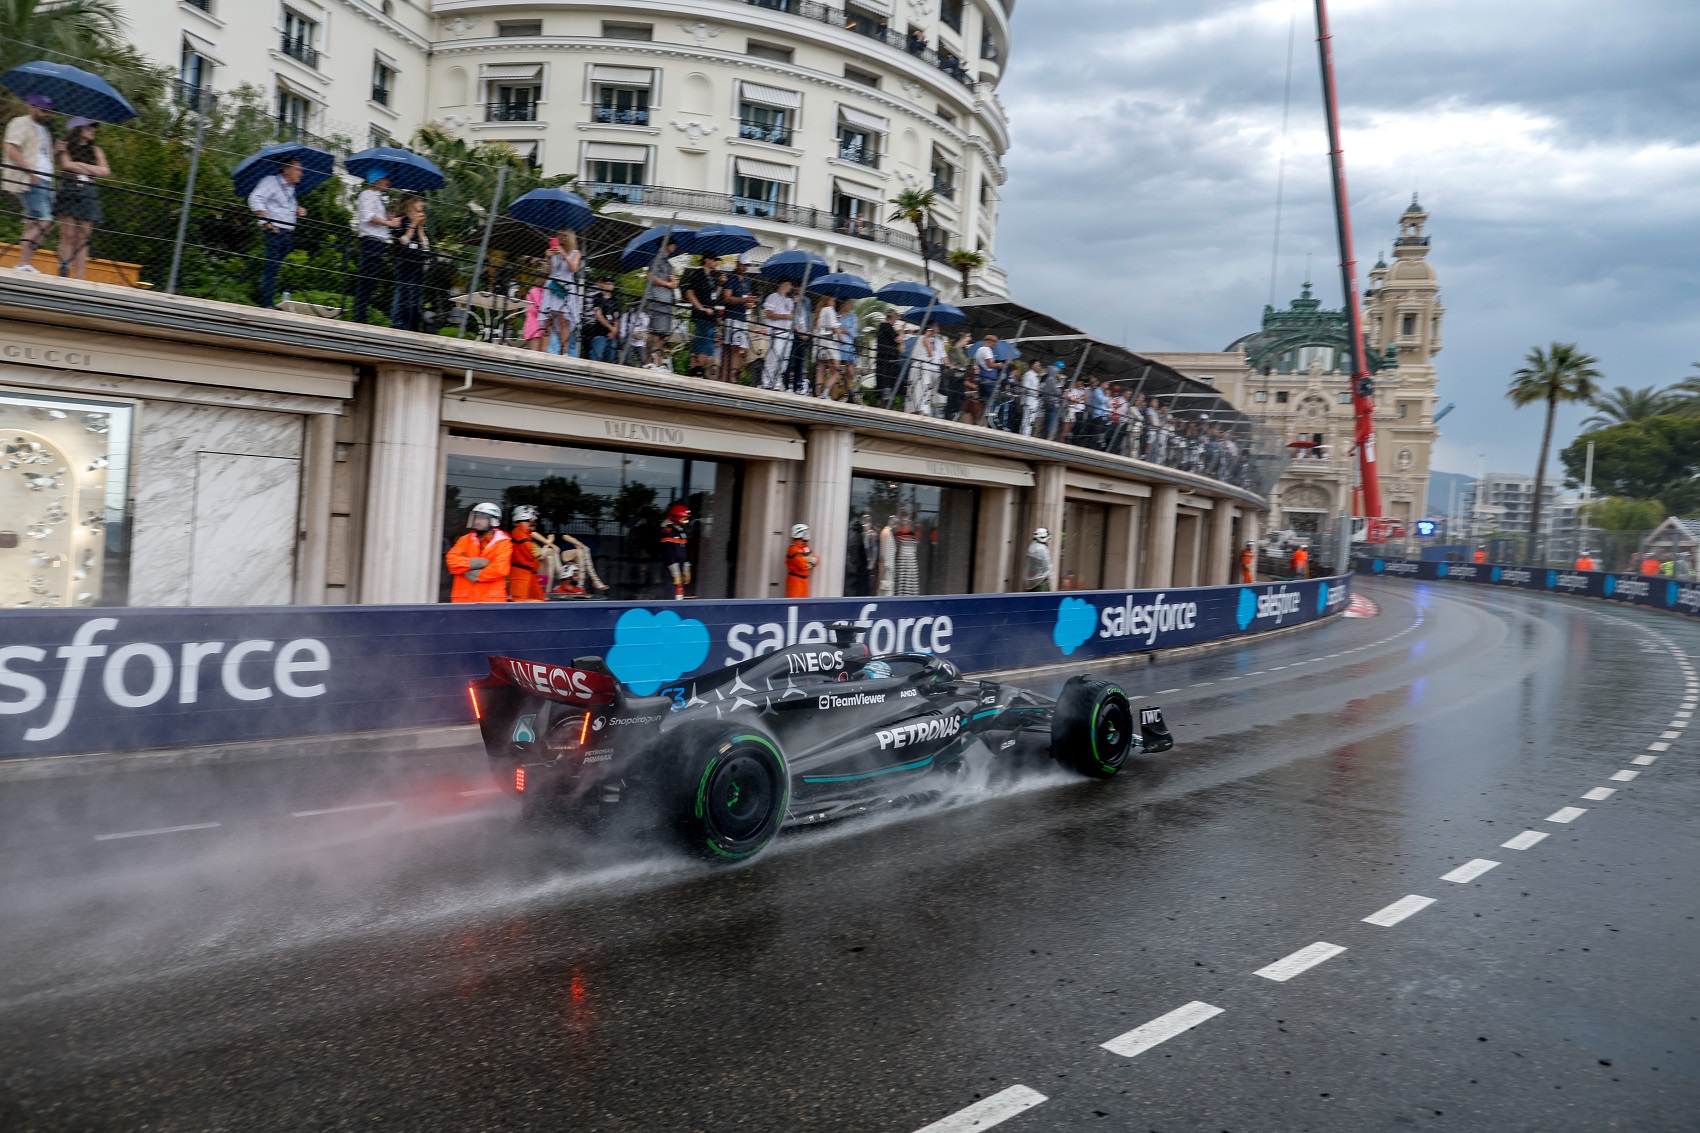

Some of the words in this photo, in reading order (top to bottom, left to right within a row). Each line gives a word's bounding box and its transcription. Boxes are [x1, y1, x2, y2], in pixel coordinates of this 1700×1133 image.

[3, 345, 91, 366] GUCCI
[604, 421, 684, 444] VALENTINO
[1099, 593, 1197, 645] salesforce
[785, 651, 844, 674] INEOS
[0, 617, 331, 741] sforce
[510, 660, 594, 700] INEOS
[830, 693, 886, 708] TeamViewer
[900, 688, 917, 698] AMD
[608, 715, 662, 727] Snapdragon
[1141, 708, 1161, 725] IWC
[875, 714, 961, 750] PETRONAS
